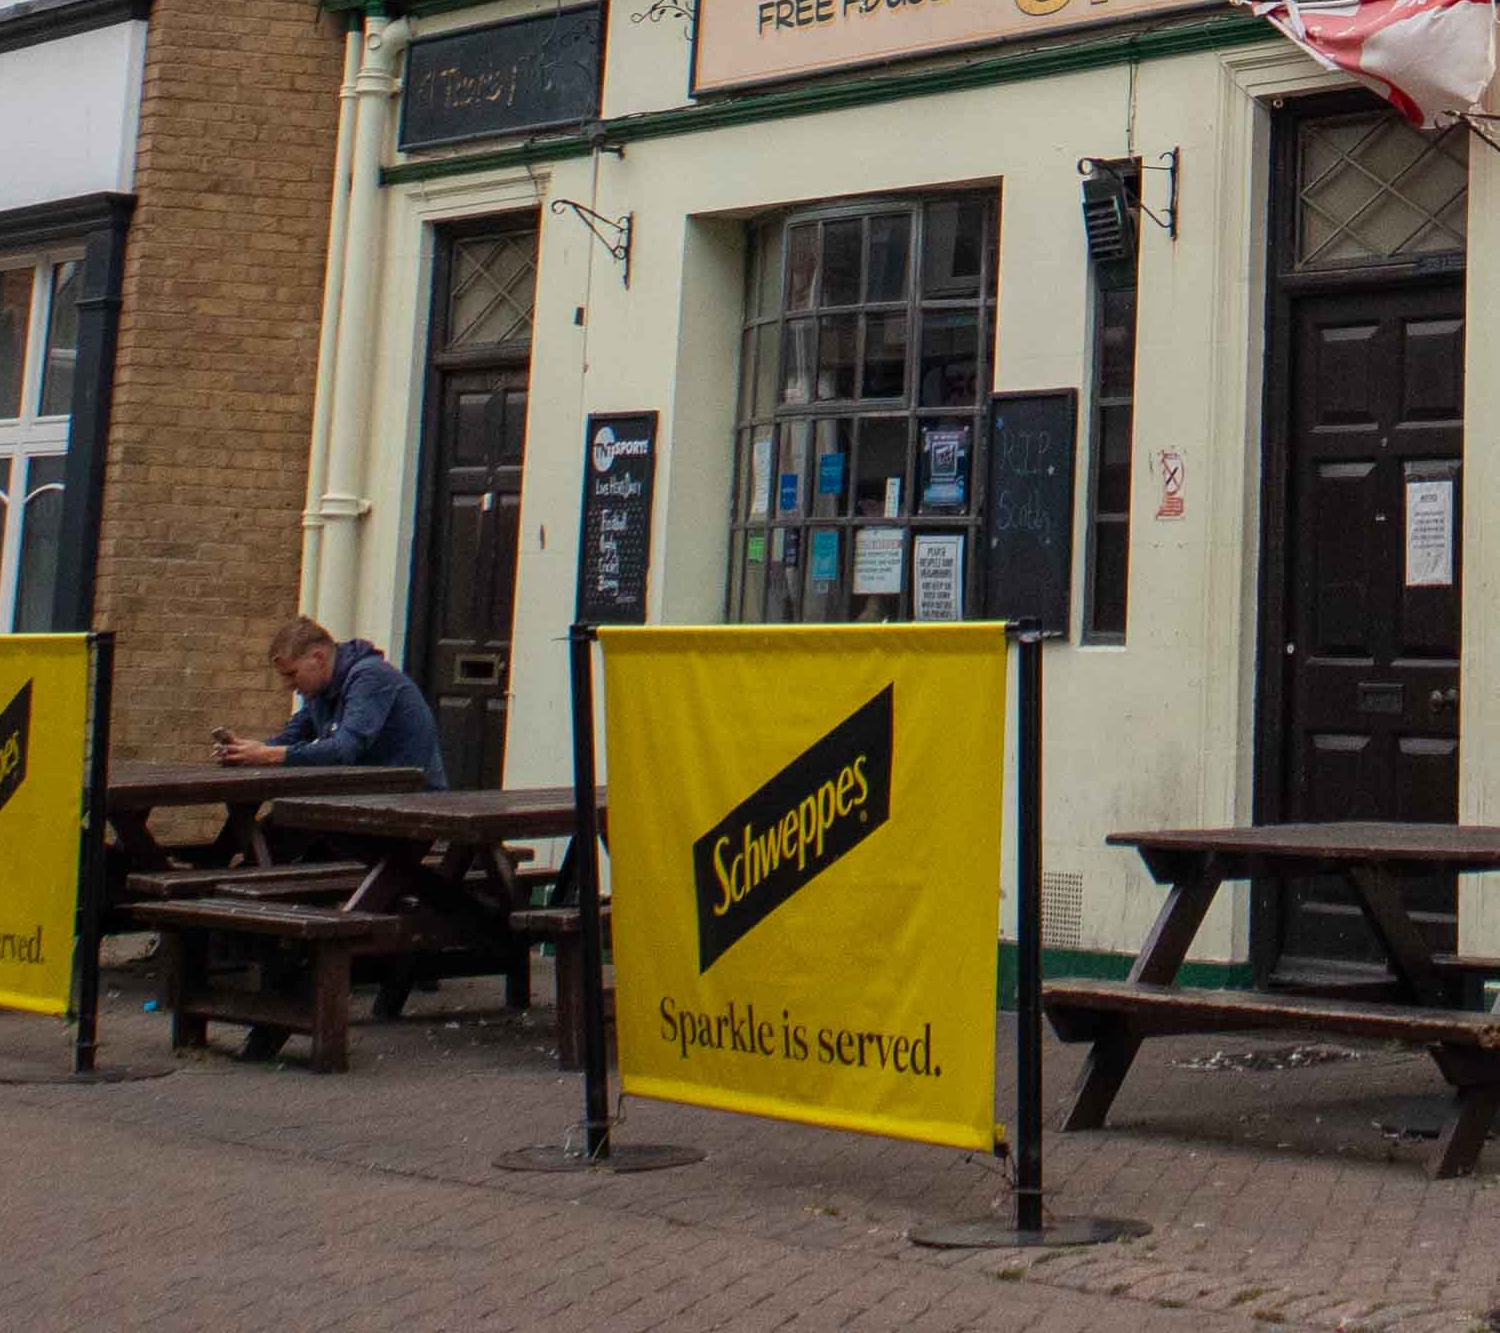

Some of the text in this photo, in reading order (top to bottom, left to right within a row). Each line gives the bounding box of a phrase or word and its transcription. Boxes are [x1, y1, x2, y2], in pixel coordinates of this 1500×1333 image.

[712, 754, 870, 917] Schweppes
[659, 995, 943, 1078] Sparkle is served.
